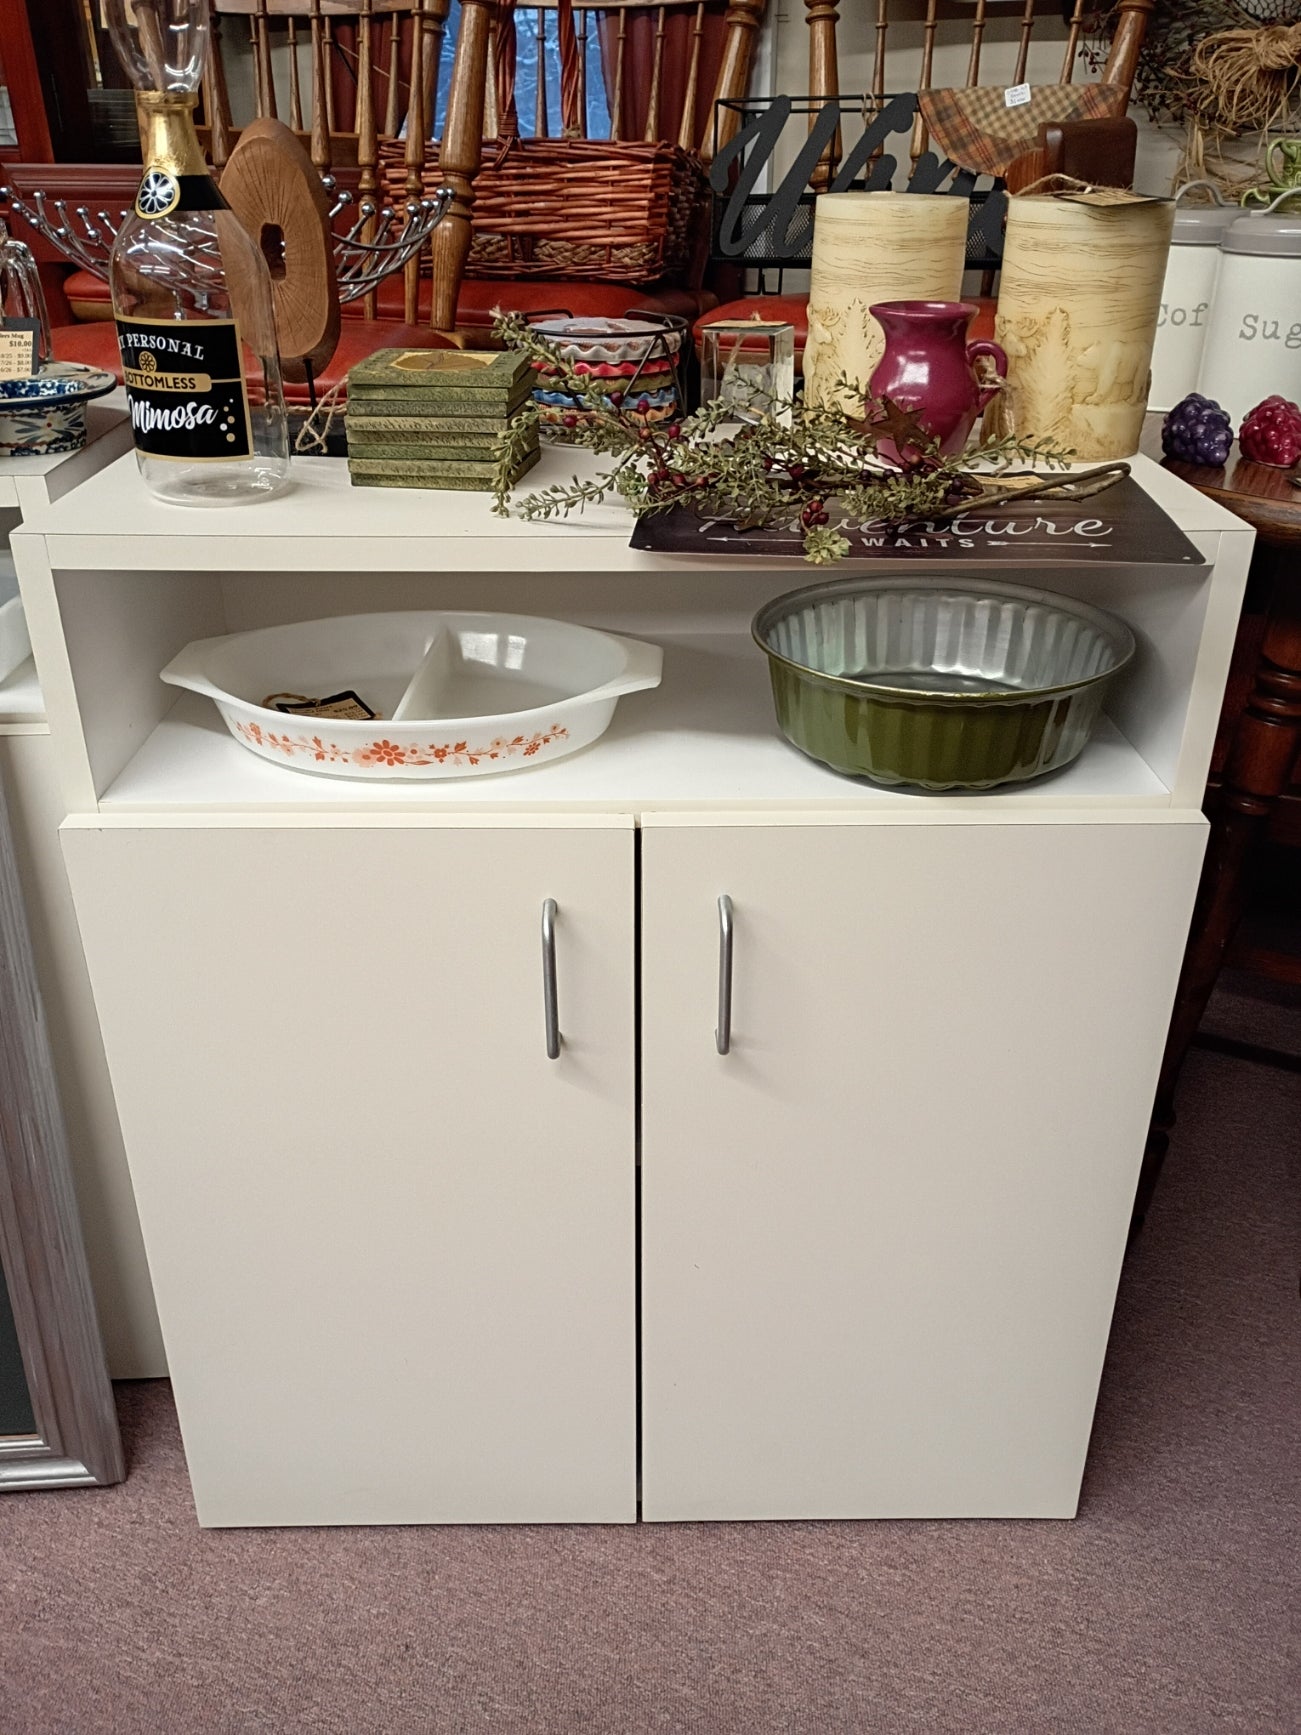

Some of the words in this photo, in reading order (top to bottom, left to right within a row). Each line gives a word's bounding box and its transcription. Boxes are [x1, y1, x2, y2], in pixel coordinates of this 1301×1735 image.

[125, 333, 205, 361] PERSONAL
[127, 393, 219, 434] Mimosa
[698, 507, 1114, 537] venture
